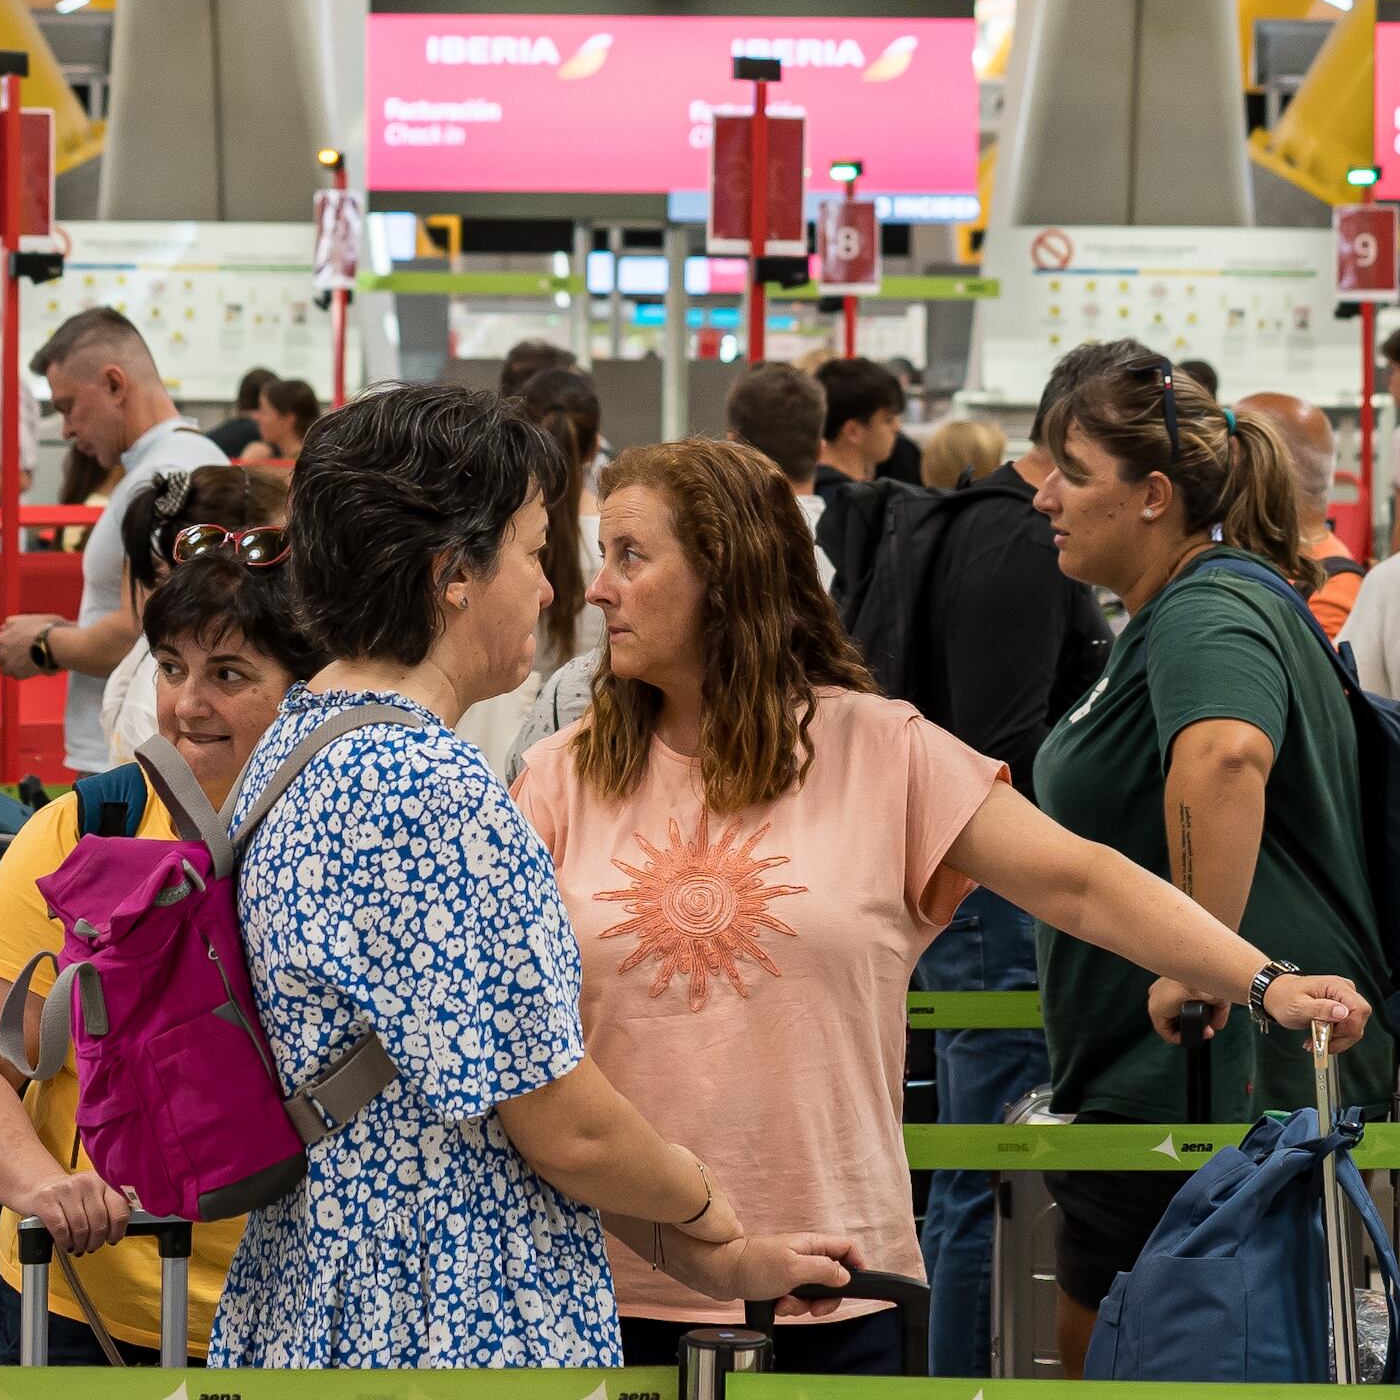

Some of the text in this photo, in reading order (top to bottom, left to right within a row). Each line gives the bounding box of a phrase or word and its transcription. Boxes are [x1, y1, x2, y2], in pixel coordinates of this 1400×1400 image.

[426, 35, 560, 65] IBERIA
[835, 226, 860, 260] 8
[1352, 232, 1379, 268] 9
[1180, 1142, 1214, 1153] aena
